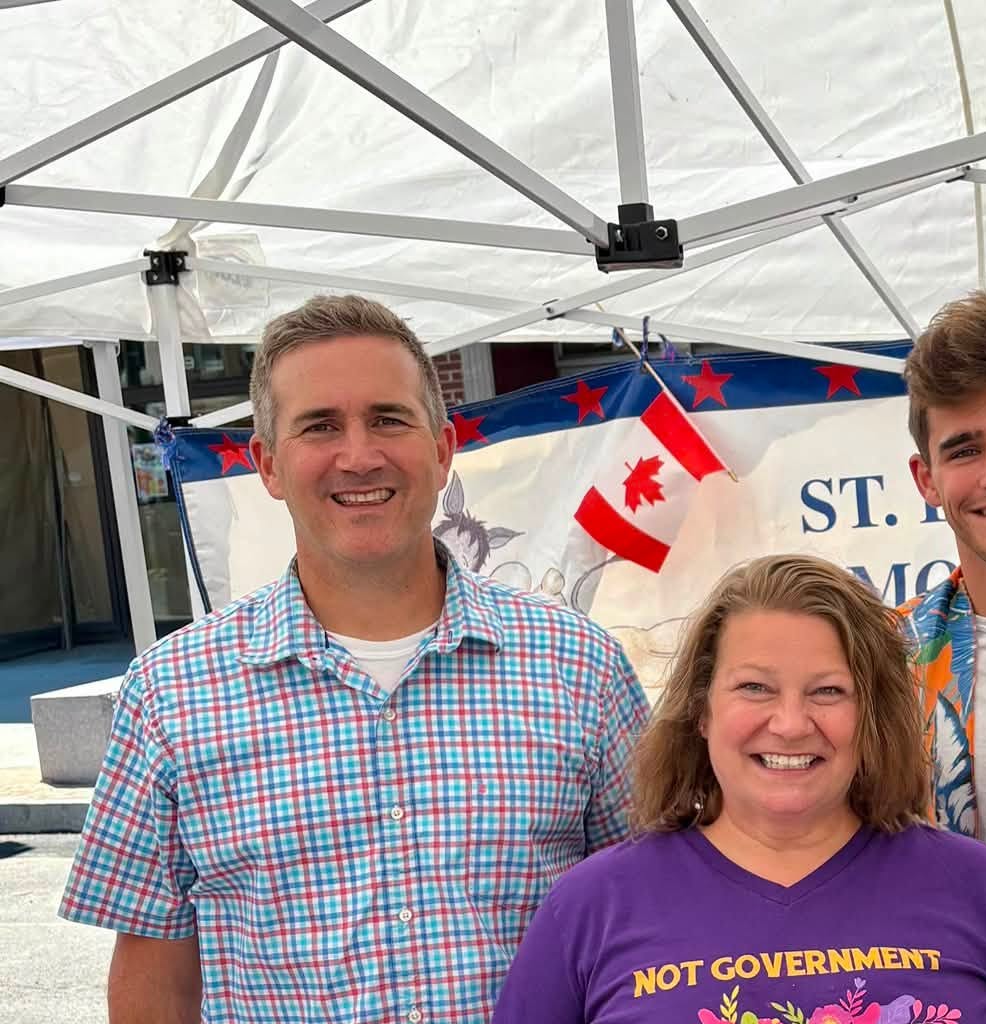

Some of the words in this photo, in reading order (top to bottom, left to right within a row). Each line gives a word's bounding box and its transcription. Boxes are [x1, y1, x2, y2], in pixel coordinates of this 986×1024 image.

[800, 474, 898, 534] ST.
[633, 959, 704, 998] NOT
[710, 945, 942, 982] GOVERNMENT
